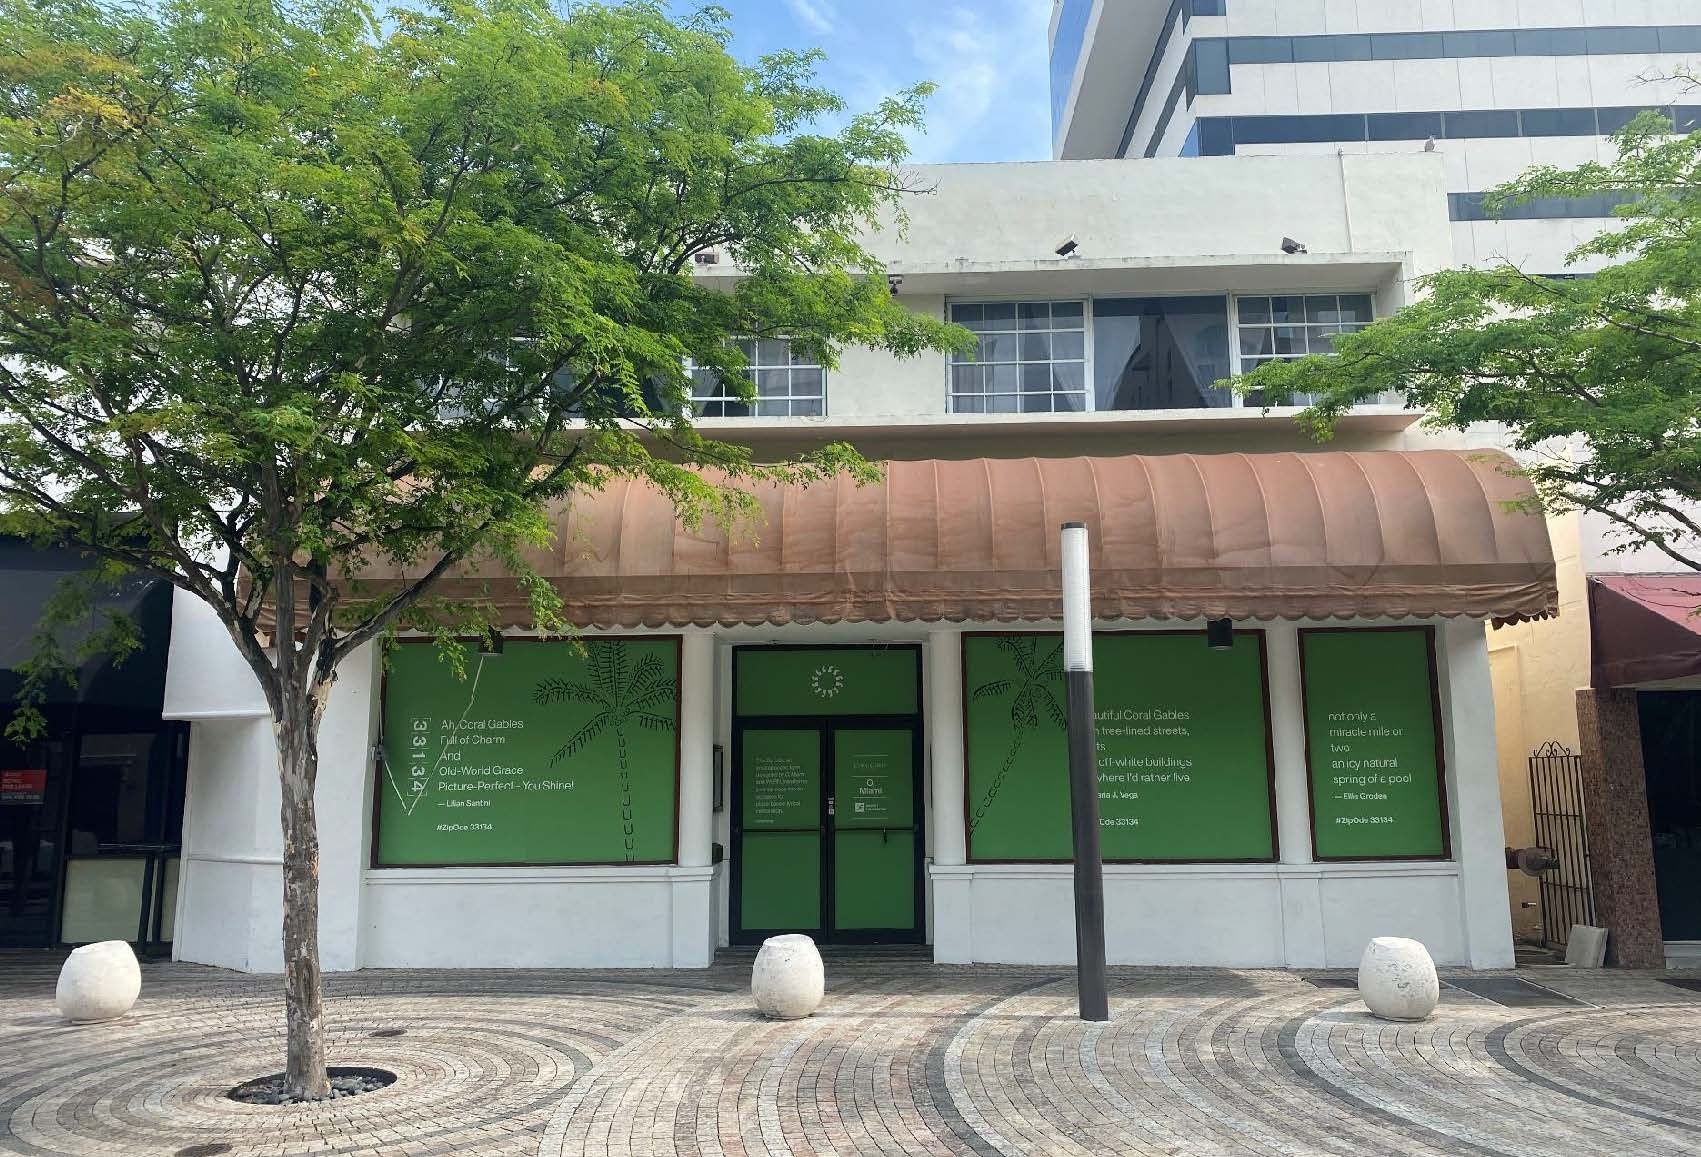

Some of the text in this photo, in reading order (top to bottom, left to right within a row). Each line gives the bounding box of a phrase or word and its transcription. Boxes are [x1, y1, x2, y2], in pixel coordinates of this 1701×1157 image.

[1093, 709, 1190, 721] autiful Coral Gables
[1328, 711, 1345, 721] not
[1346, 711, 1368, 723] only
[459, 719, 485, 730] Coral
[488, 719, 524, 729] Gables
[1102, 725, 1151, 736] tree-lined
[1153, 725, 1190, 737] streets,
[1329, 726, 1403, 737] miracle mile or
[440, 735, 505, 745] Full of Charm
[1330, 743, 1350, 752] two
[440, 750, 461, 761] And
[1145, 757, 1193, 769] buildings
[1332, 757, 1398, 771] an icy natural
[439, 765, 524, 776] Old-World Grace
[1097, 772, 1190, 782] here I'd rather live
[1333, 774, 1366, 786] spring
[1367, 774, 1378, 783] of
[1388, 773, 1412, 785] pool
[522, 780, 541, 791] You
[542, 780, 574, 790] Shine!
